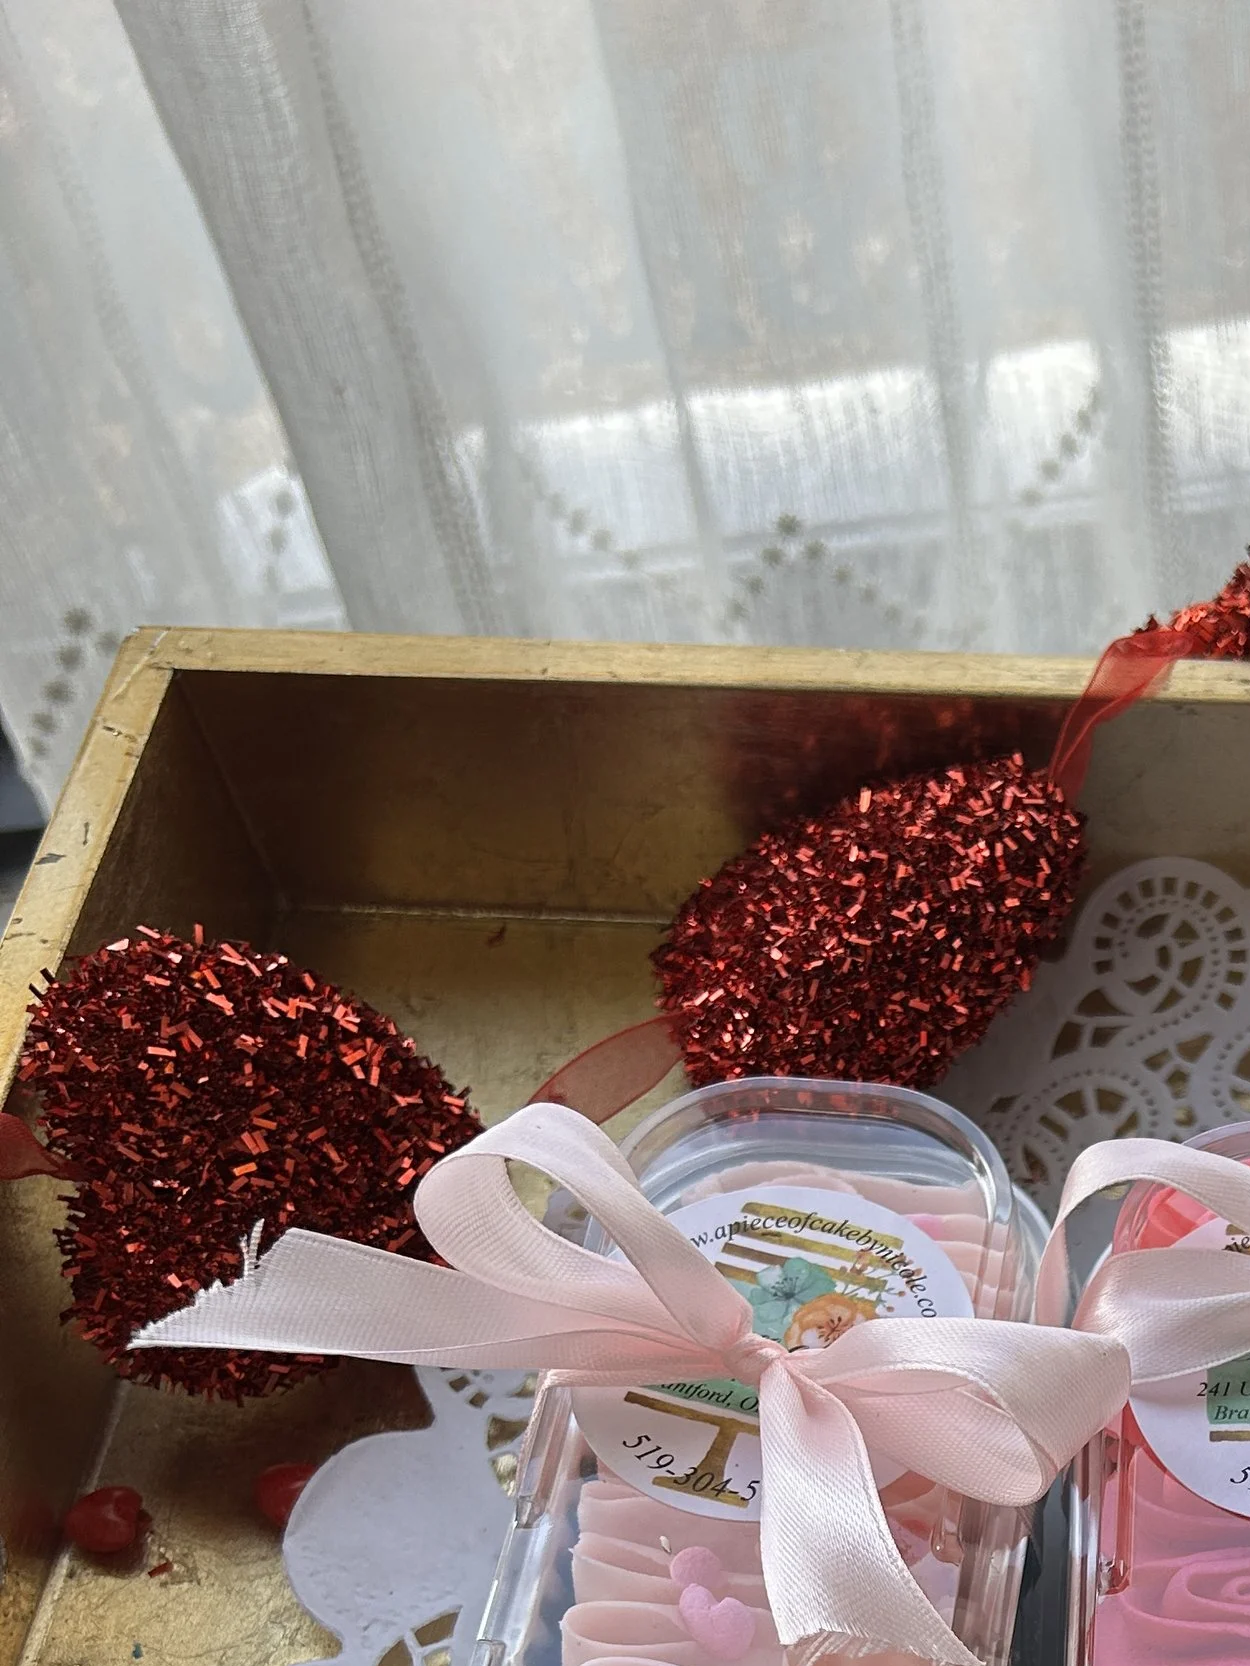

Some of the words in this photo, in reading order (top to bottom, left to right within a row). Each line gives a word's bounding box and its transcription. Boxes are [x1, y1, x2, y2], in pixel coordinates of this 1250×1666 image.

[690, 1211, 938, 1319] w.apieceofcakebynicole.co
[1196, 1381, 1232, 1397] 241
[622, 1433, 760, 1501] 519-304-5
